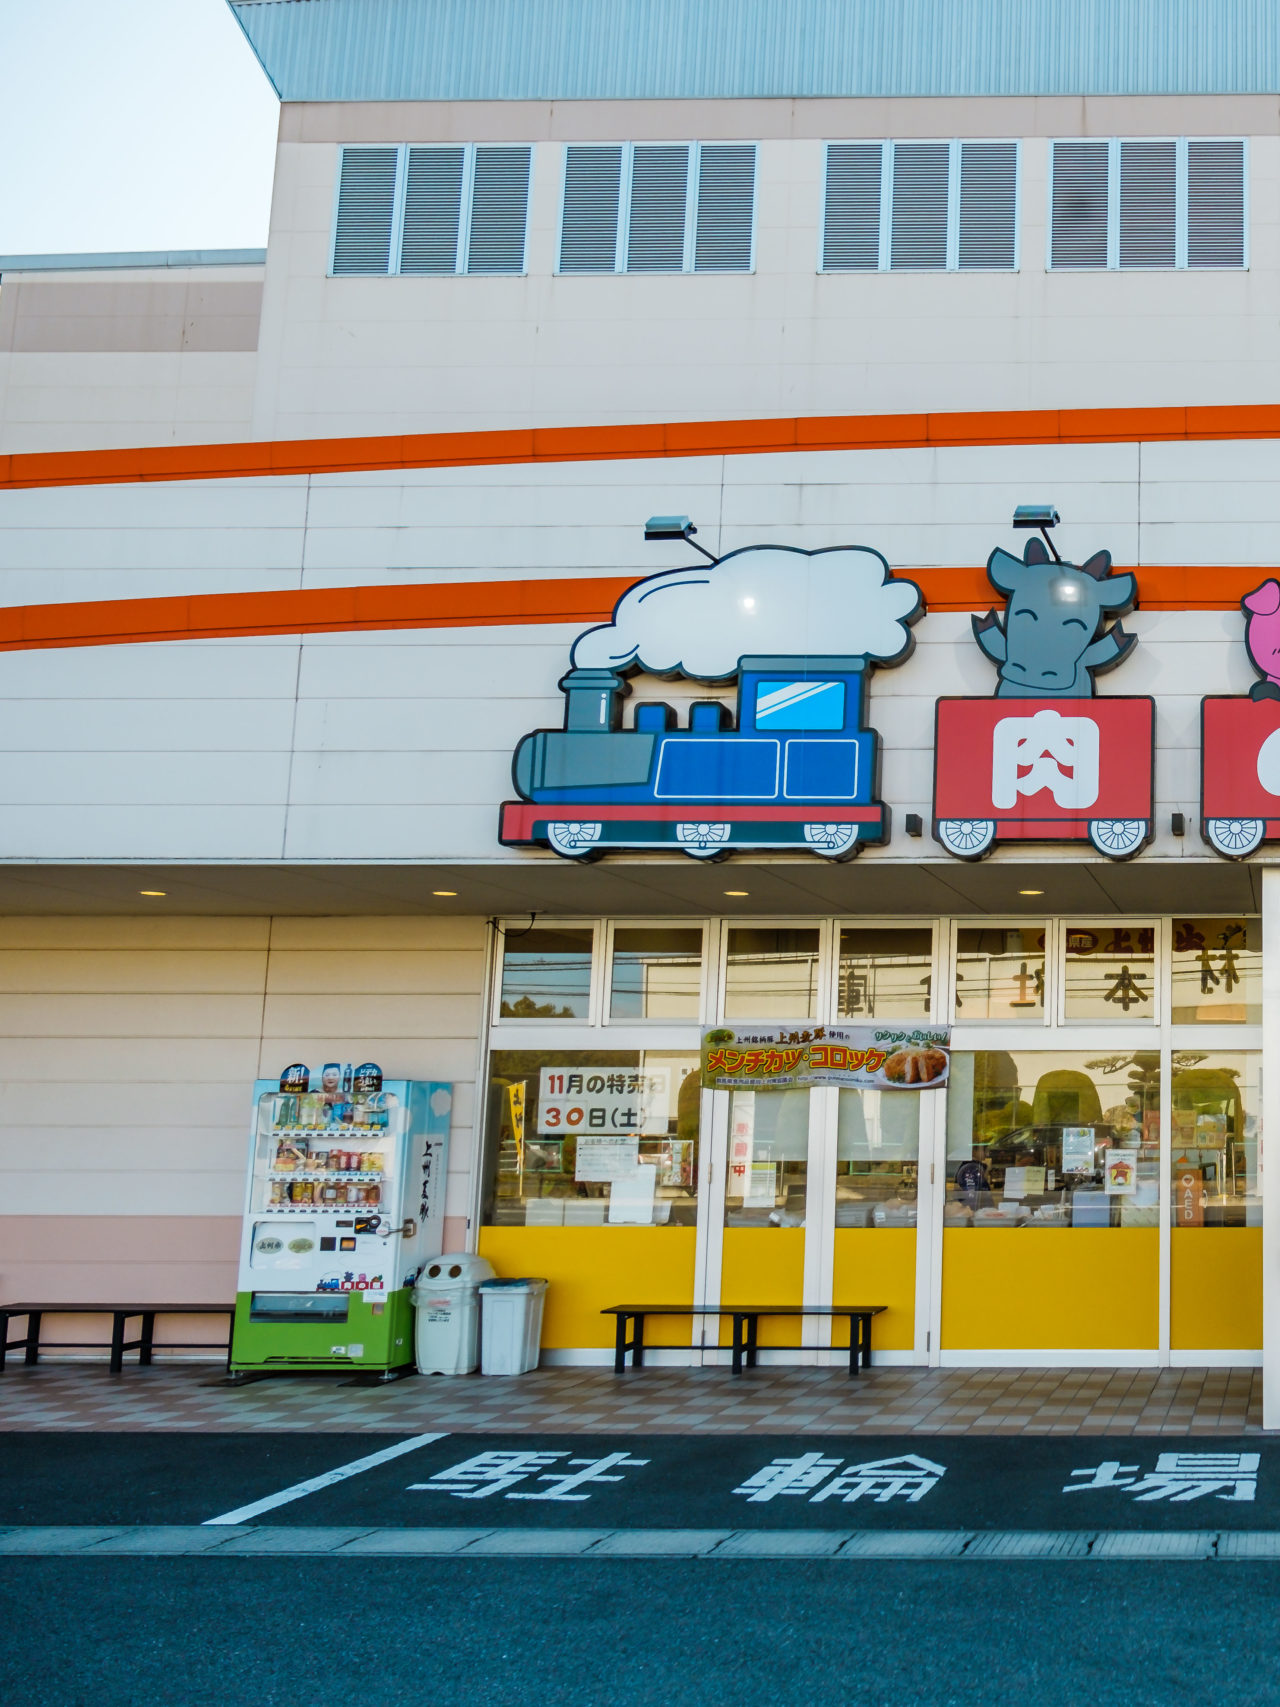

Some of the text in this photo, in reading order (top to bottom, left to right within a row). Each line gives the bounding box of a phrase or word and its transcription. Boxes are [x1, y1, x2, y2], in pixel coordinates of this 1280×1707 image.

[707, 1045, 887, 1075] メンチカツ・コロッケ
[1183, 1188, 1194, 1220] AED
[405, 1451, 1261, 1503] 駐輪場
